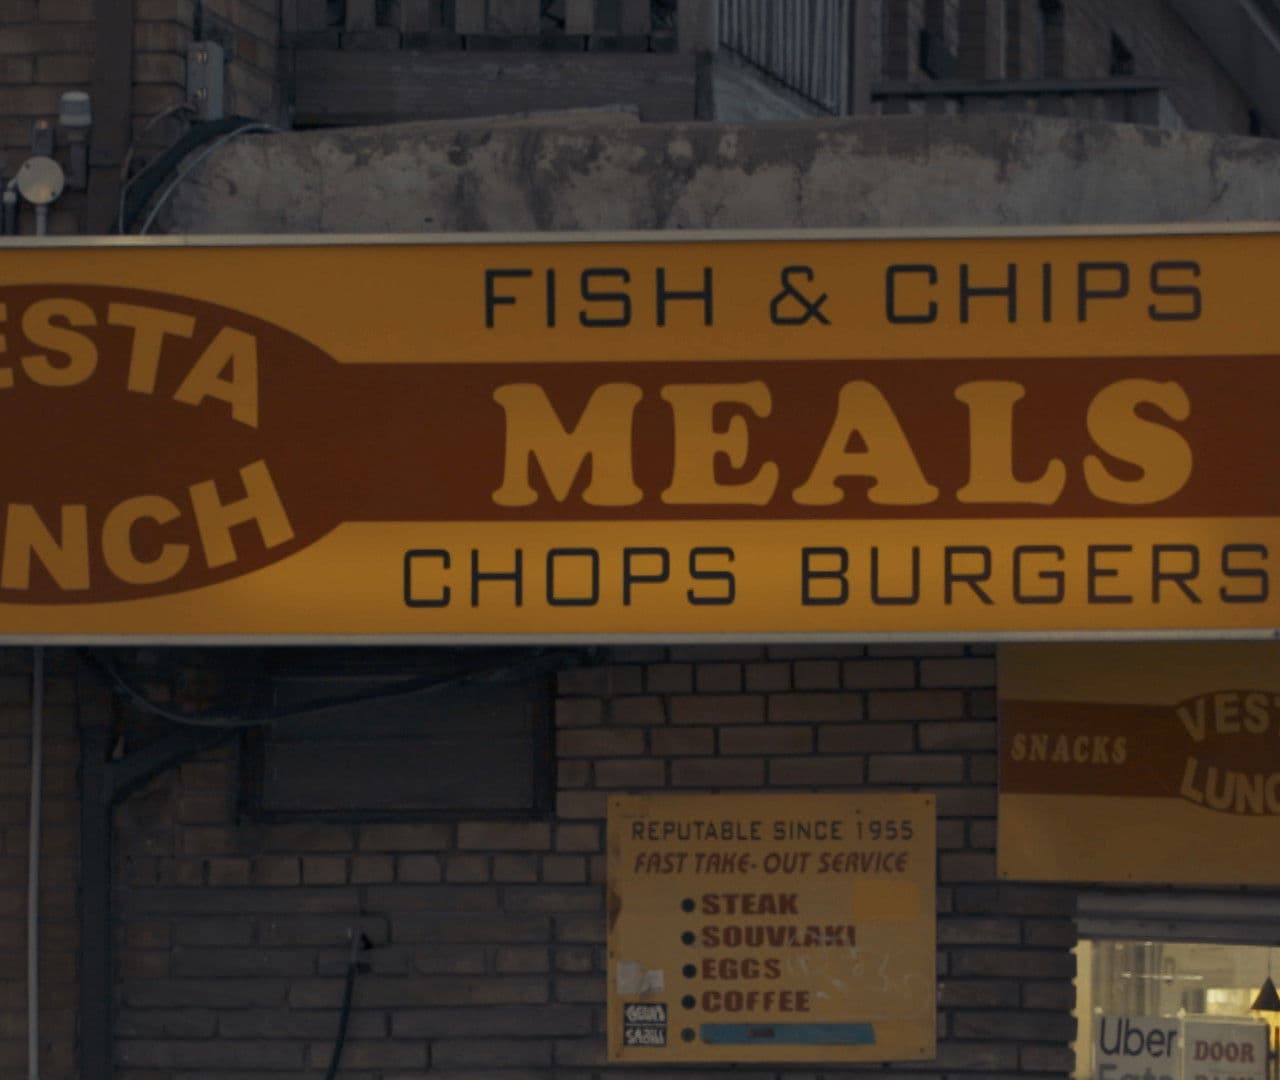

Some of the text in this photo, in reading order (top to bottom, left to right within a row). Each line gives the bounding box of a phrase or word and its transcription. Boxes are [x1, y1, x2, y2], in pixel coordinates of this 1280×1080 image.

[485, 261, 1203, 329] FISH & CHIPS
[492, 378, 1194, 507] MEALS
[403, 543, 1270, 608] CHOPS BURGERS
[1010, 732, 1128, 765] SNACKS
[632, 820, 914, 841] REPUTABLE SINCE 1955
[634, 852, 688, 874] FAST
[817, 851, 910, 874] SERVICE
[702, 893, 799, 915] STEAK
[701, 925, 857, 947] SOUVLAKI
[702, 958, 782, 980] EGGS
[702, 990, 811, 1012] COFFEE
[1099, 1018, 1178, 1058] Uber
[1194, 1040, 1255, 1063] DOOR
